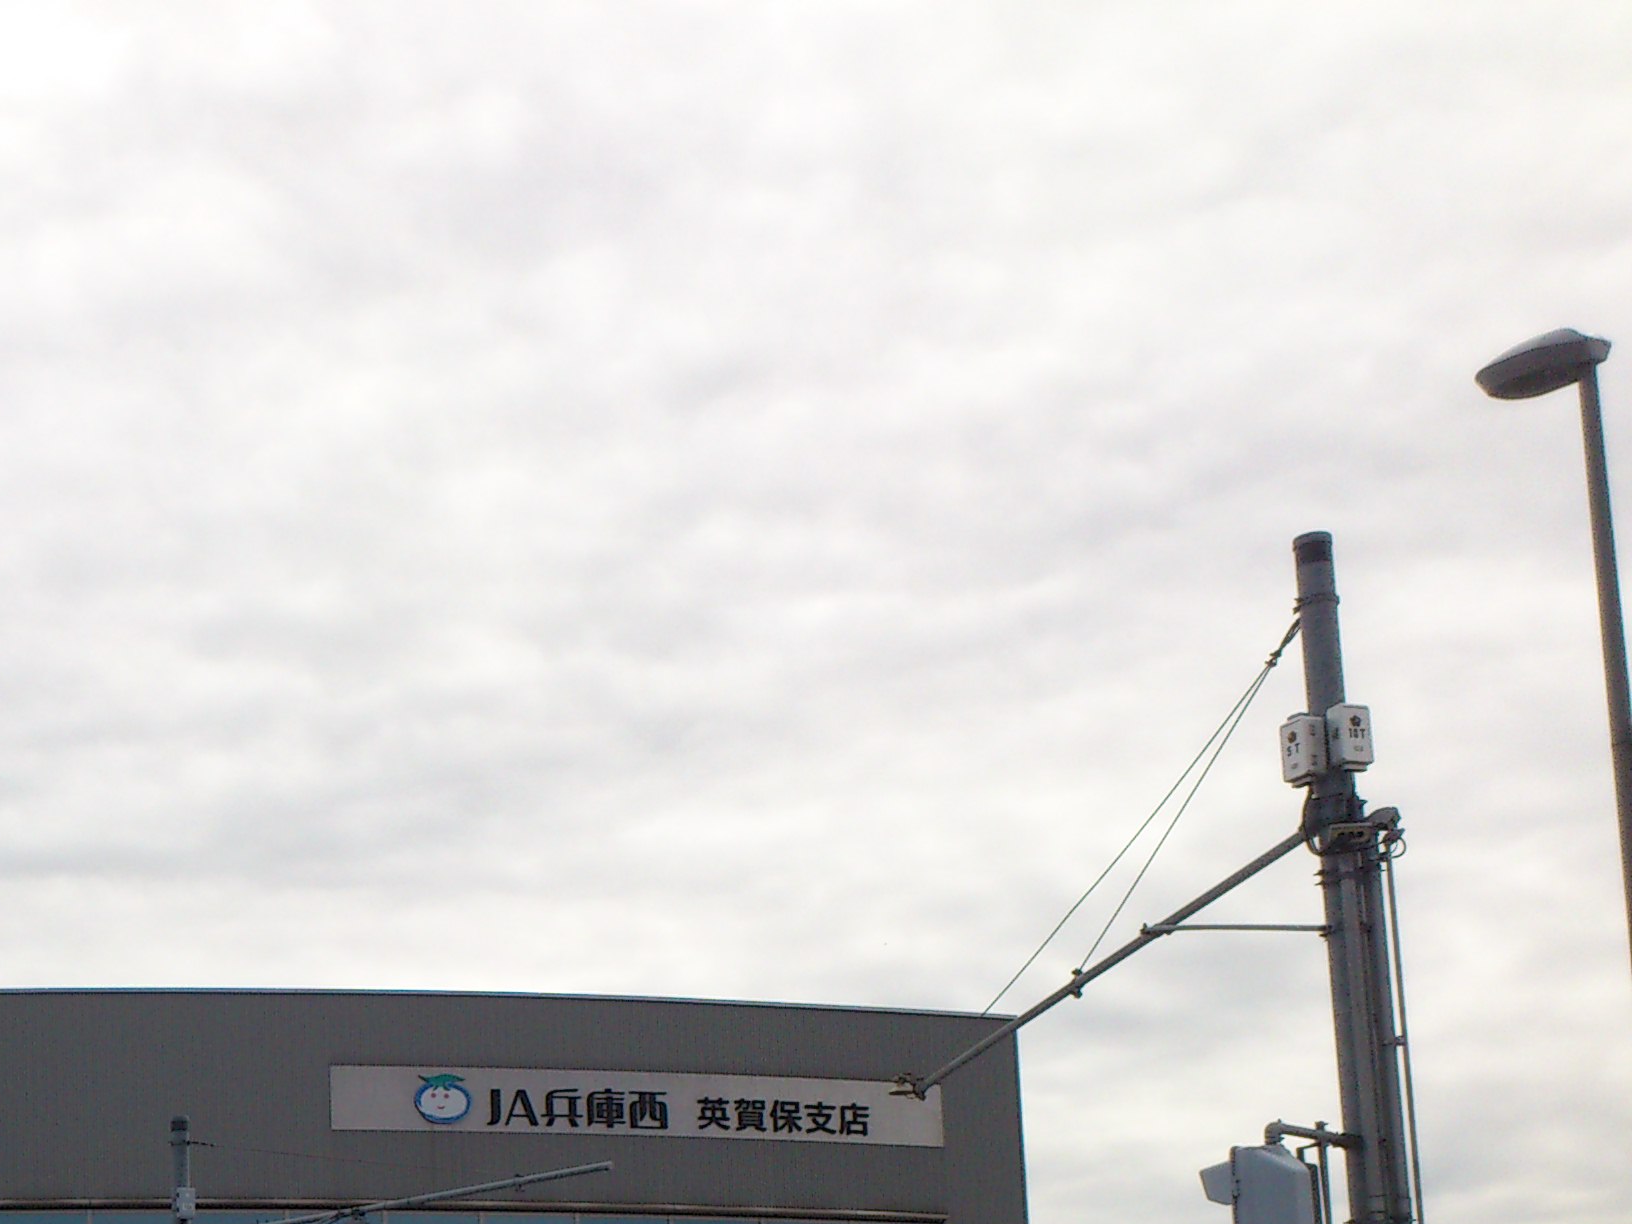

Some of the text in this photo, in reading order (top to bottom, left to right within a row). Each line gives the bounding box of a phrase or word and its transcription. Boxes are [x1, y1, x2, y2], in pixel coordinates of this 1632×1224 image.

[487, 1087, 871, 1137] JA兵庫西 英賀保支店
